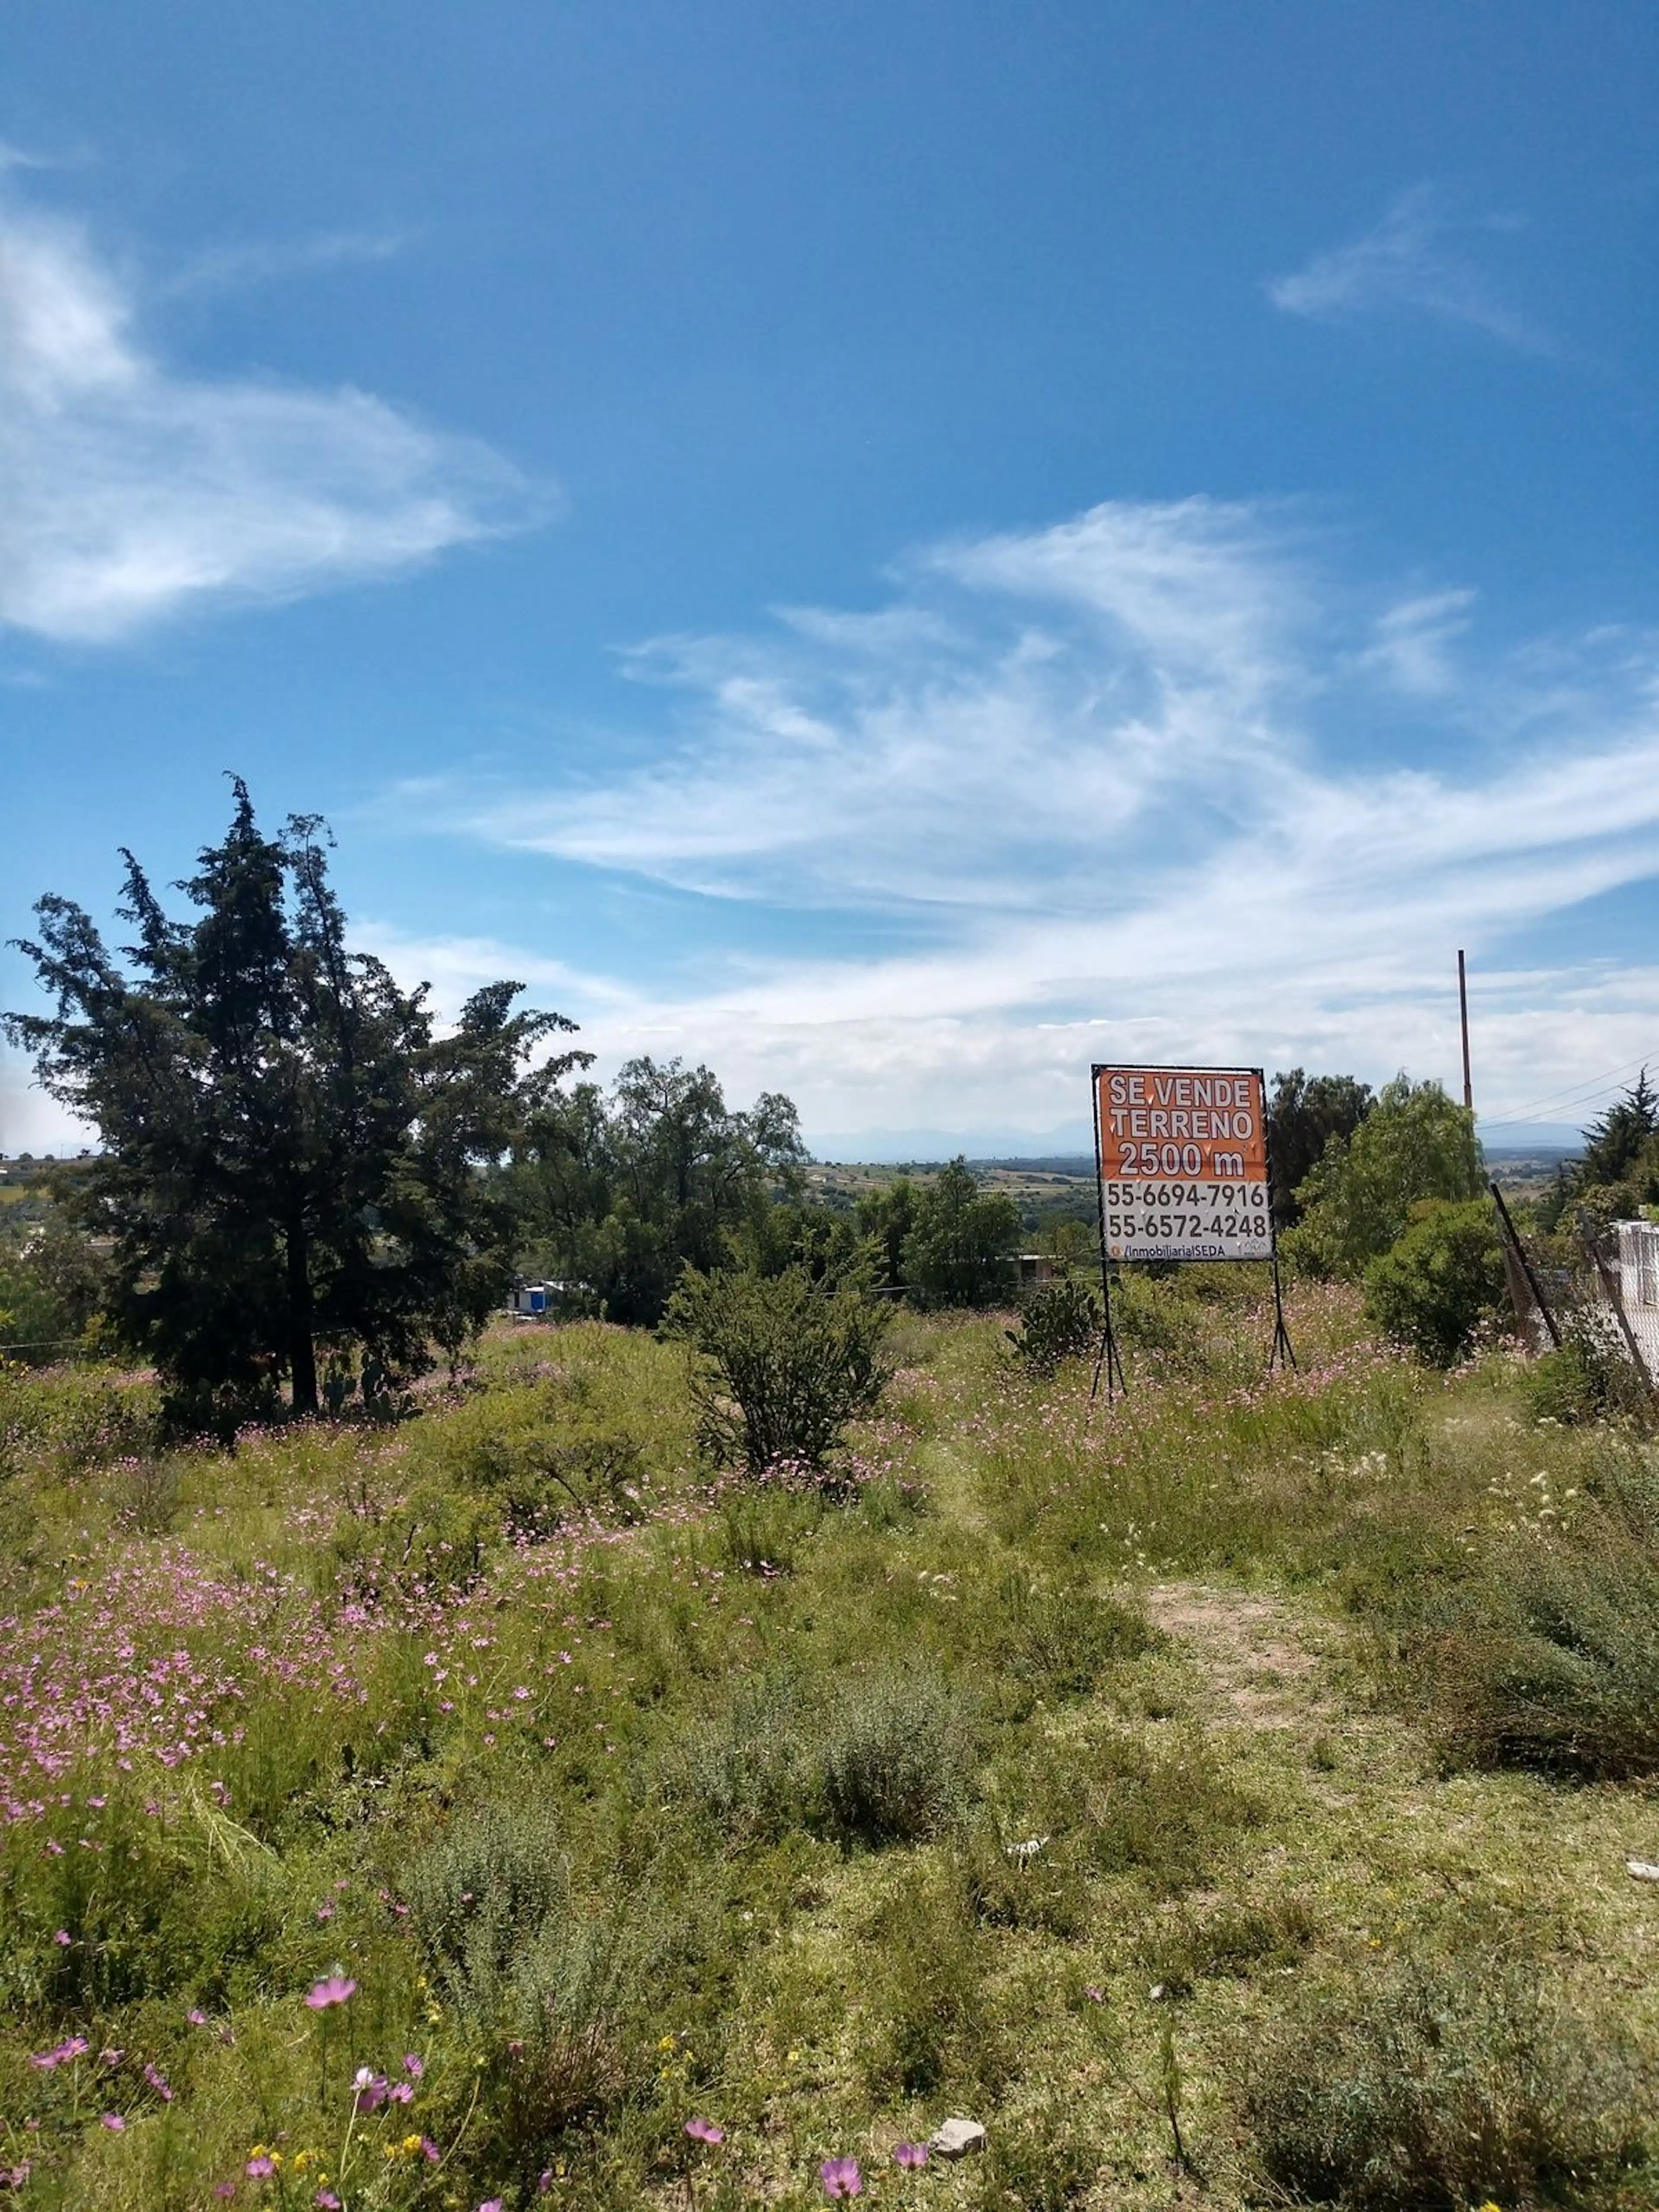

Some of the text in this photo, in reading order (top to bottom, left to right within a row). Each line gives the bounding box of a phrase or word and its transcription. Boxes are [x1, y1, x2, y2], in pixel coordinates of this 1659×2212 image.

[1109, 1075, 1251, 1108] SE VENDE
[1109, 1107, 1253, 1140] TERRENO
[1119, 1142, 1202, 1176] 2500
[1108, 1183, 1264, 1207] 55-6694-7916
[1109, 1214, 1266, 1238] 55-6572-4248
